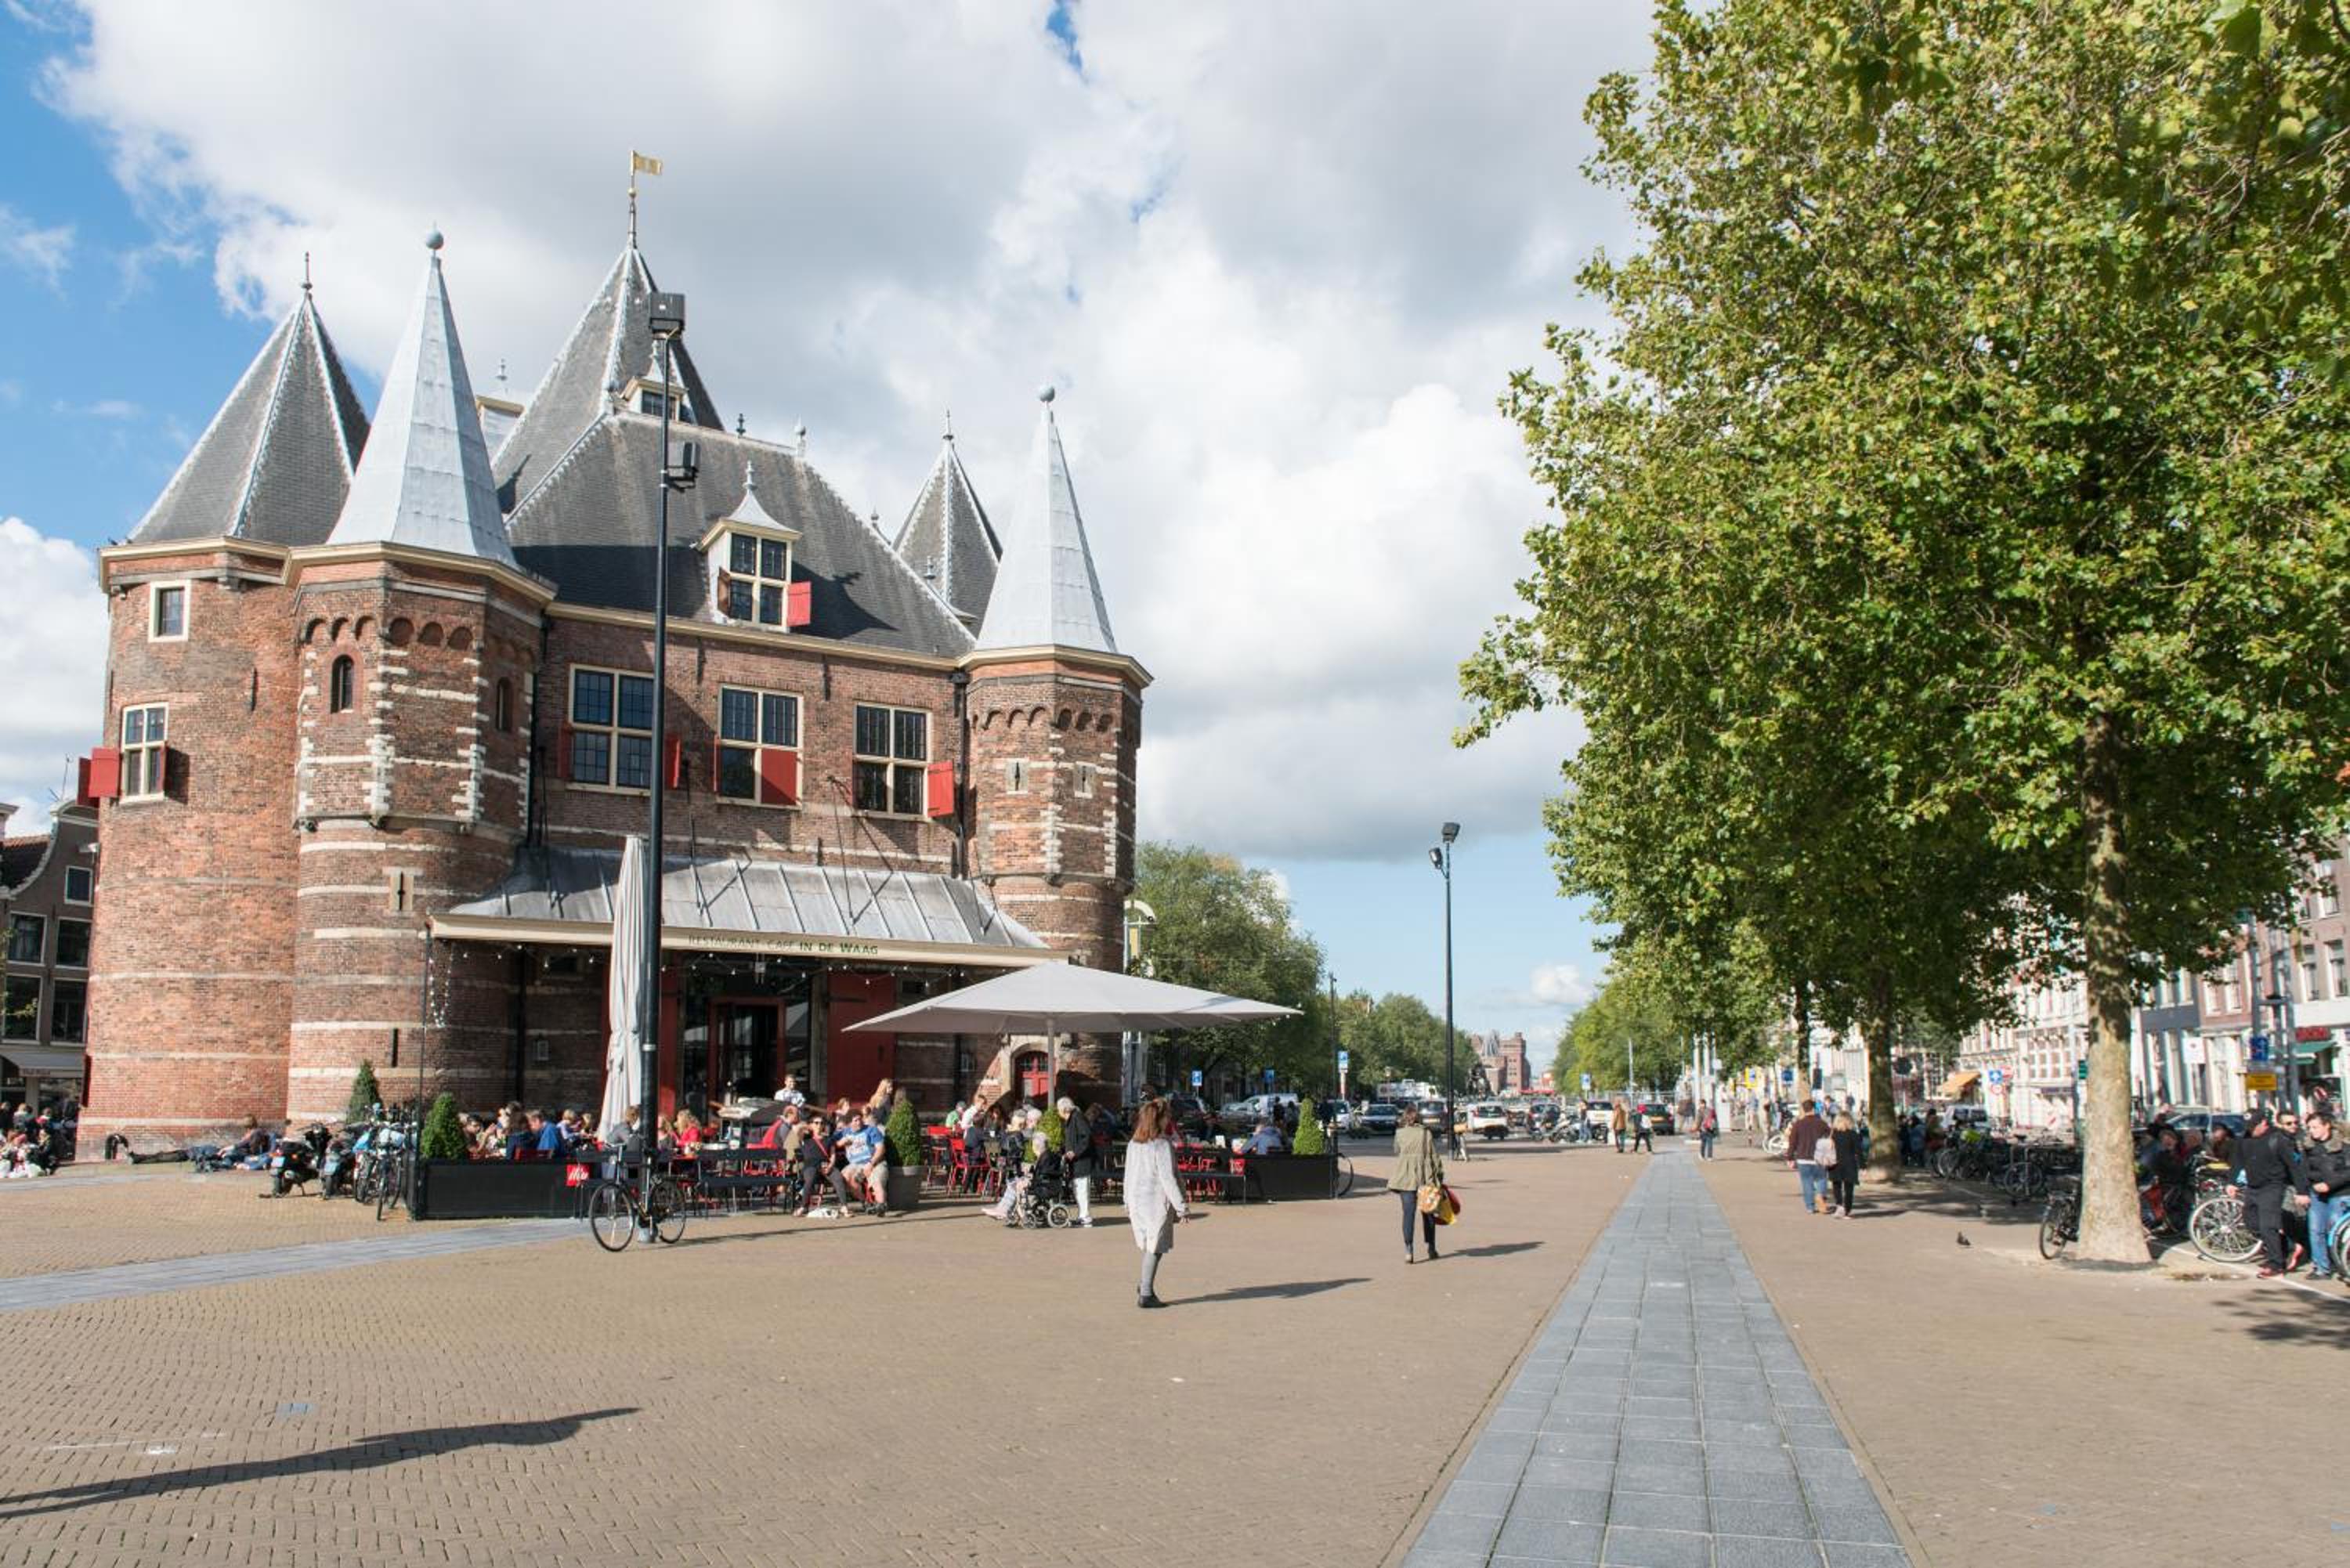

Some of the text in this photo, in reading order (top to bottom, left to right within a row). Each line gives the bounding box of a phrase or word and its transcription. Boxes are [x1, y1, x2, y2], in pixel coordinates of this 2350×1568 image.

[800, 941, 812, 951] IN
[819, 942, 834, 952] DE
[840, 941, 878, 955] WAAG
